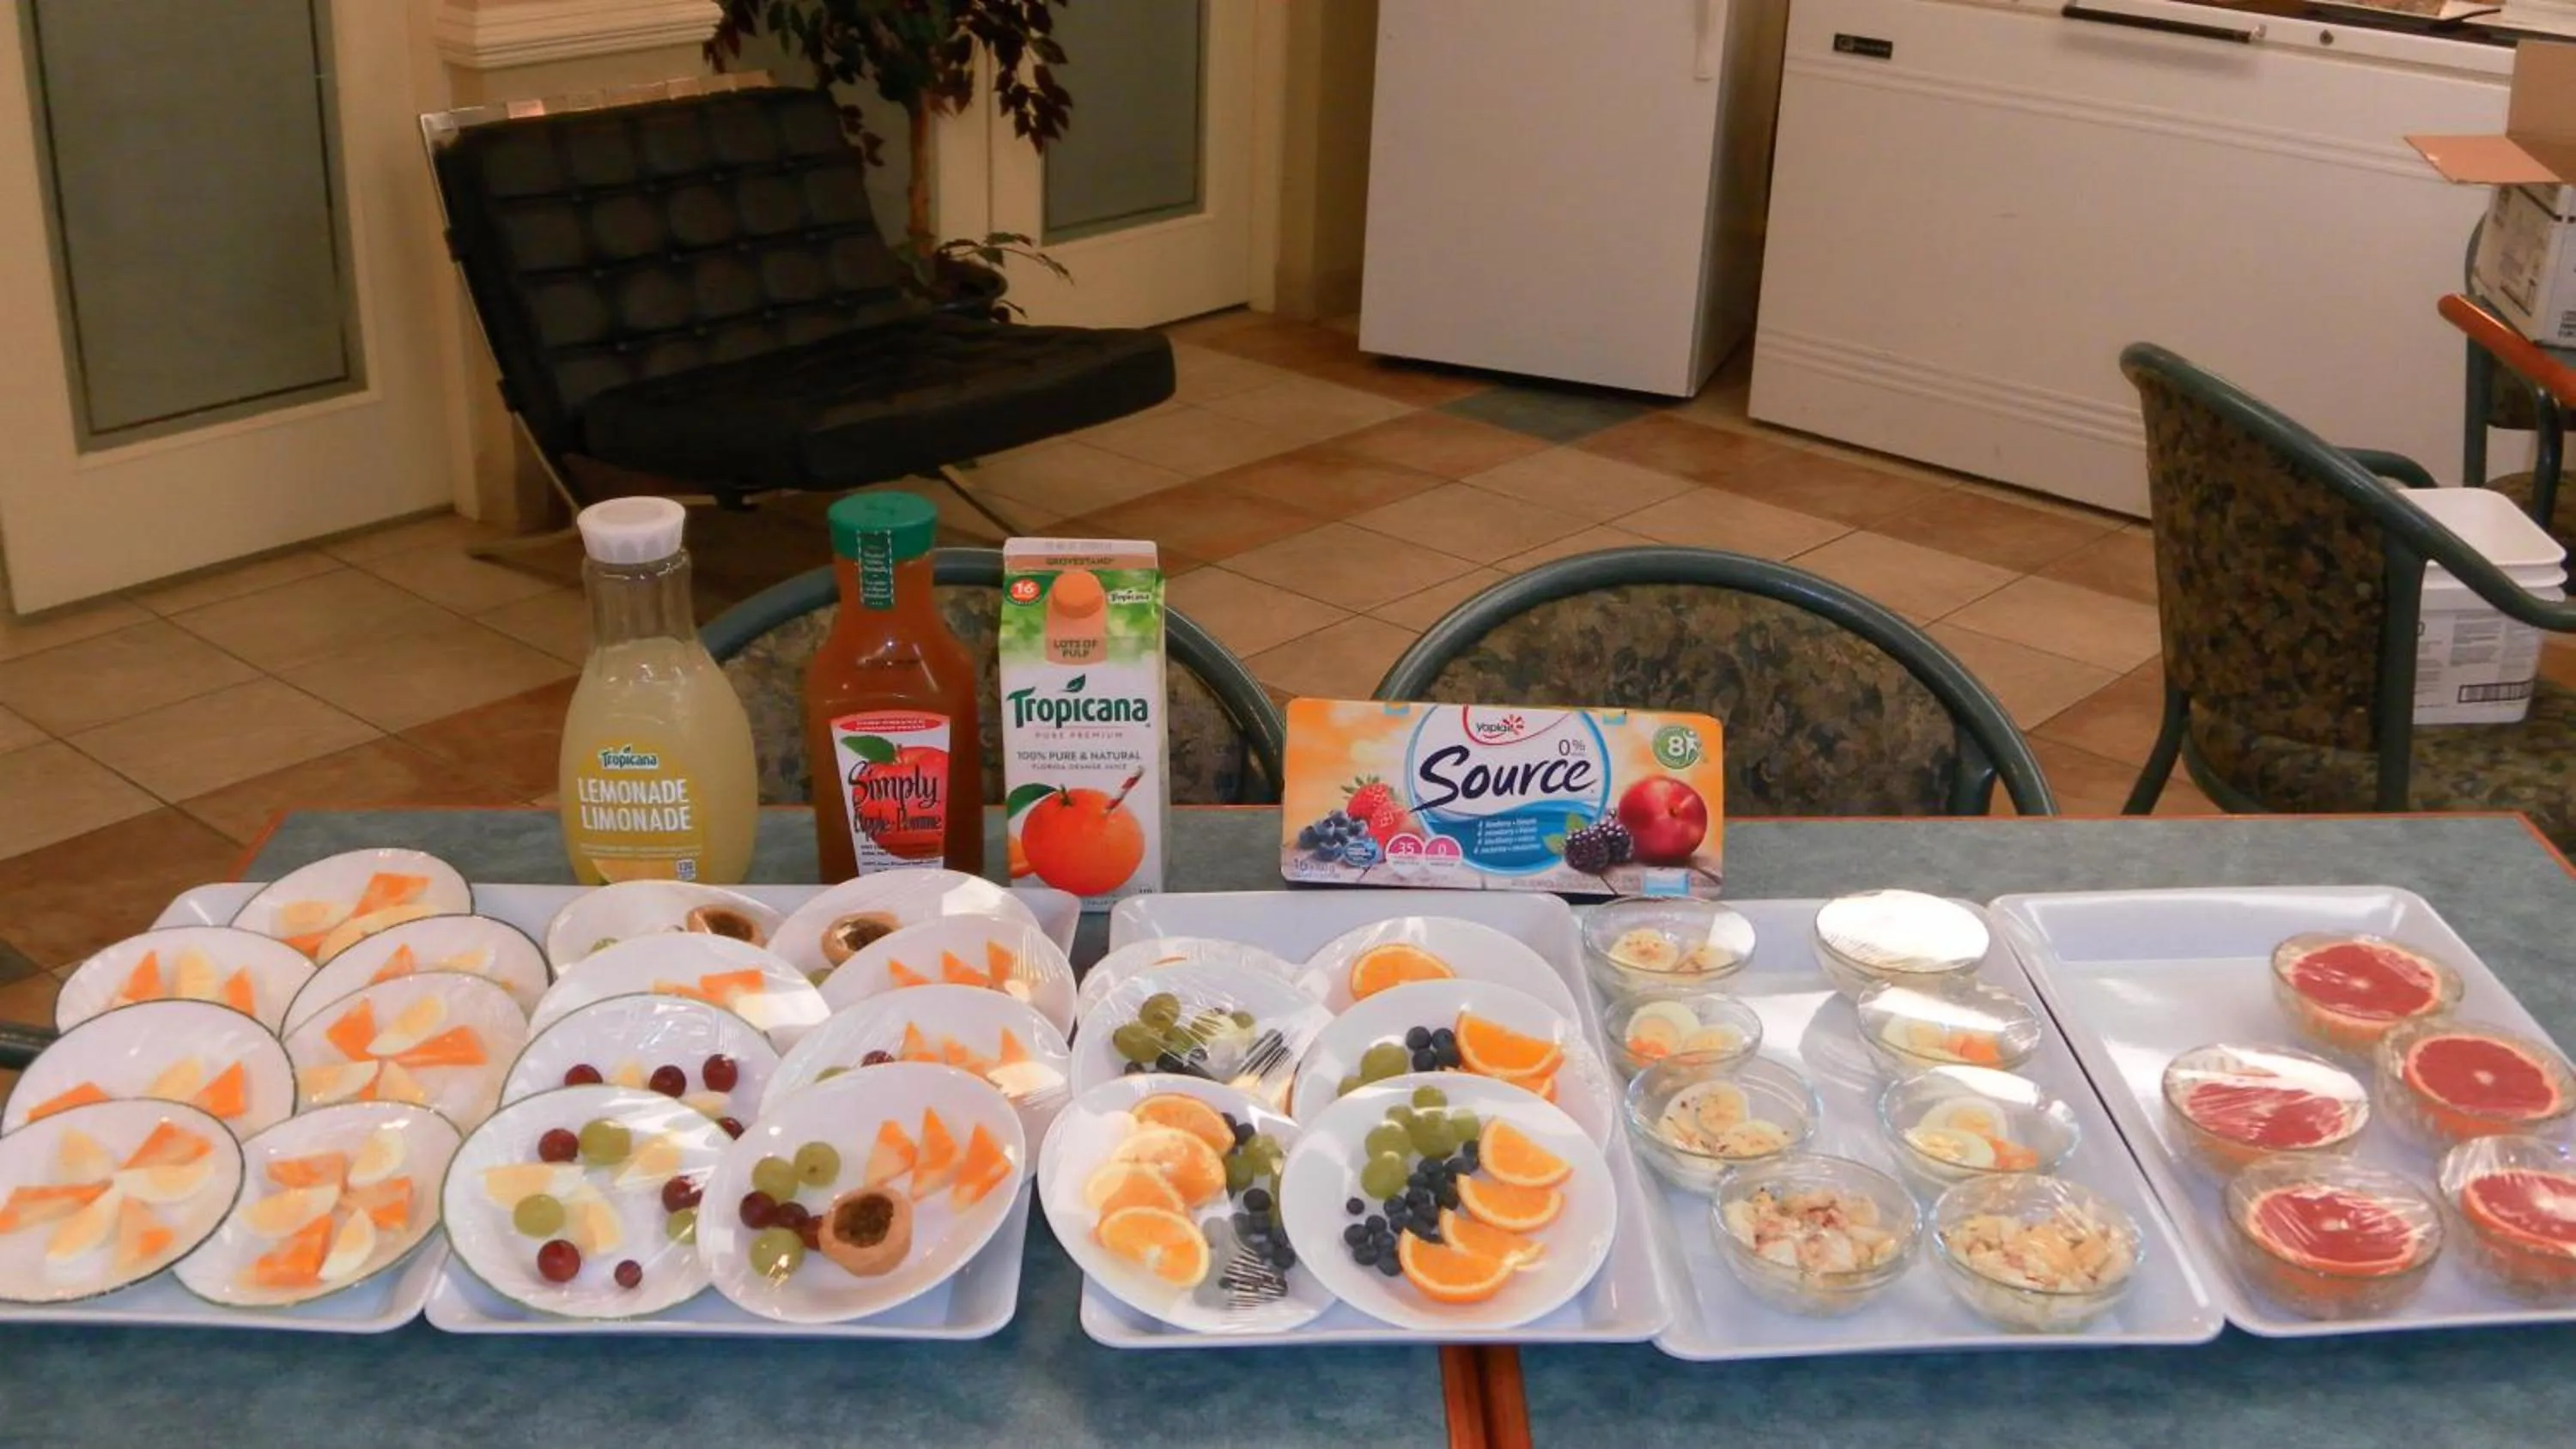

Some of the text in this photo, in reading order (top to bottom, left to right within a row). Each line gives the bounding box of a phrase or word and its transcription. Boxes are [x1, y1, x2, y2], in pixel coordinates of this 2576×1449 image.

[1016, 581, 1035, 594] 16
[1006, 687, 1149, 729] Tropicana
[601, 750, 658, 768] Tropicana
[1016, 751, 1047, 761] 100%
[1048, 751, 1074, 761] PURE
[1090, 751, 1141, 761] NATURAL
[1668, 736, 1685, 756] 8
[578, 778, 690, 804] LEMONADE
[848, 761, 940, 809] Simply
[1406, 744, 1597, 813] Source
[581, 805, 694, 832] LIMONADE
